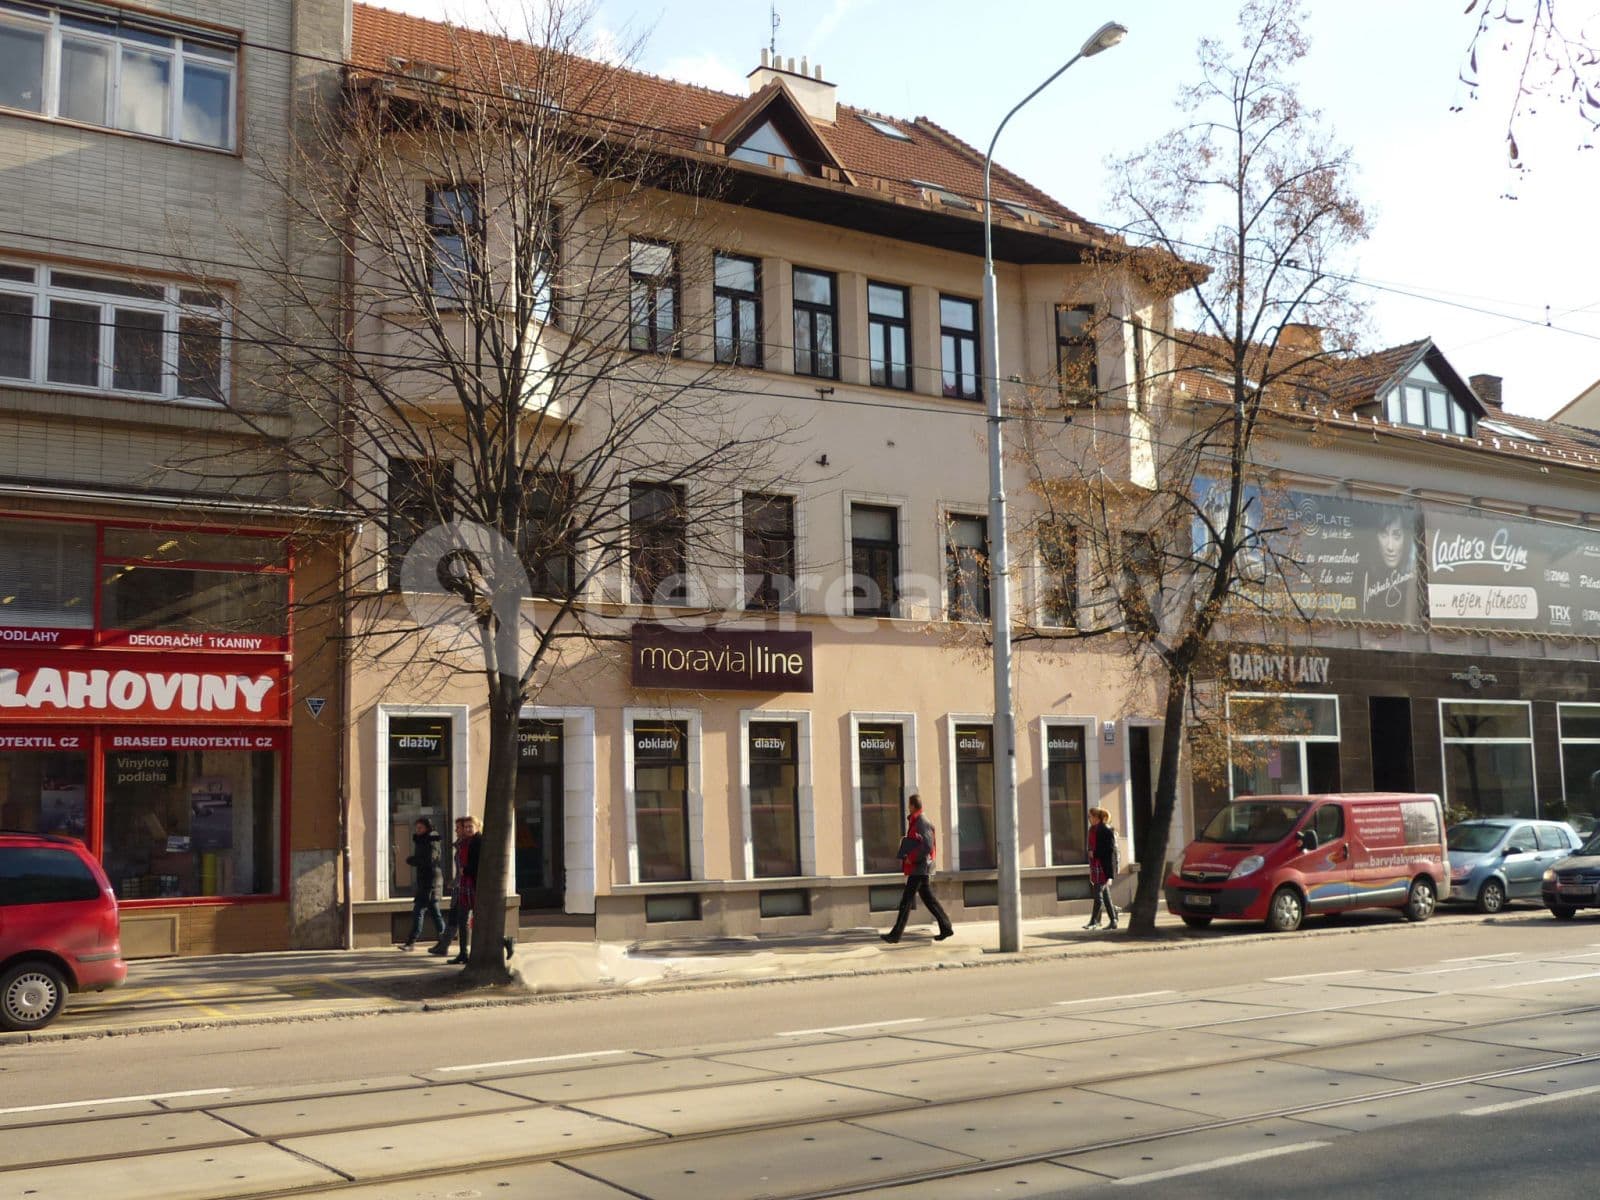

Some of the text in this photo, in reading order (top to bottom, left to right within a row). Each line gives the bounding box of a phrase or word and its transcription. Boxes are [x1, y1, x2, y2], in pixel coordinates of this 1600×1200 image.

[1315, 512, 1352, 528] PLATE
[1432, 527, 1528, 572] Ladie's Gym
[1451, 590, 1482, 617] nejen
[1485, 588, 1528, 617] fitness
[1548, 604, 1571, 620] TRX
[128, 633, 262, 649] DEKORAČNÍ TKANINY
[756, 646, 803, 674] line
[1230, 651, 1287, 682] BARVY
[60, 737, 79, 748] CZ
[113, 736, 273, 748] BRASED EUROTEXTIL CZ
[399, 735, 438, 750] dlažby
[638, 737, 679, 751] obklady
[754, 737, 786, 751] dlažby
[860, 738, 896, 751] obklady
[959, 738, 985, 750] dlažby
[1048, 738, 1078, 751] obklady
[118, 771, 167, 784] podlaha
